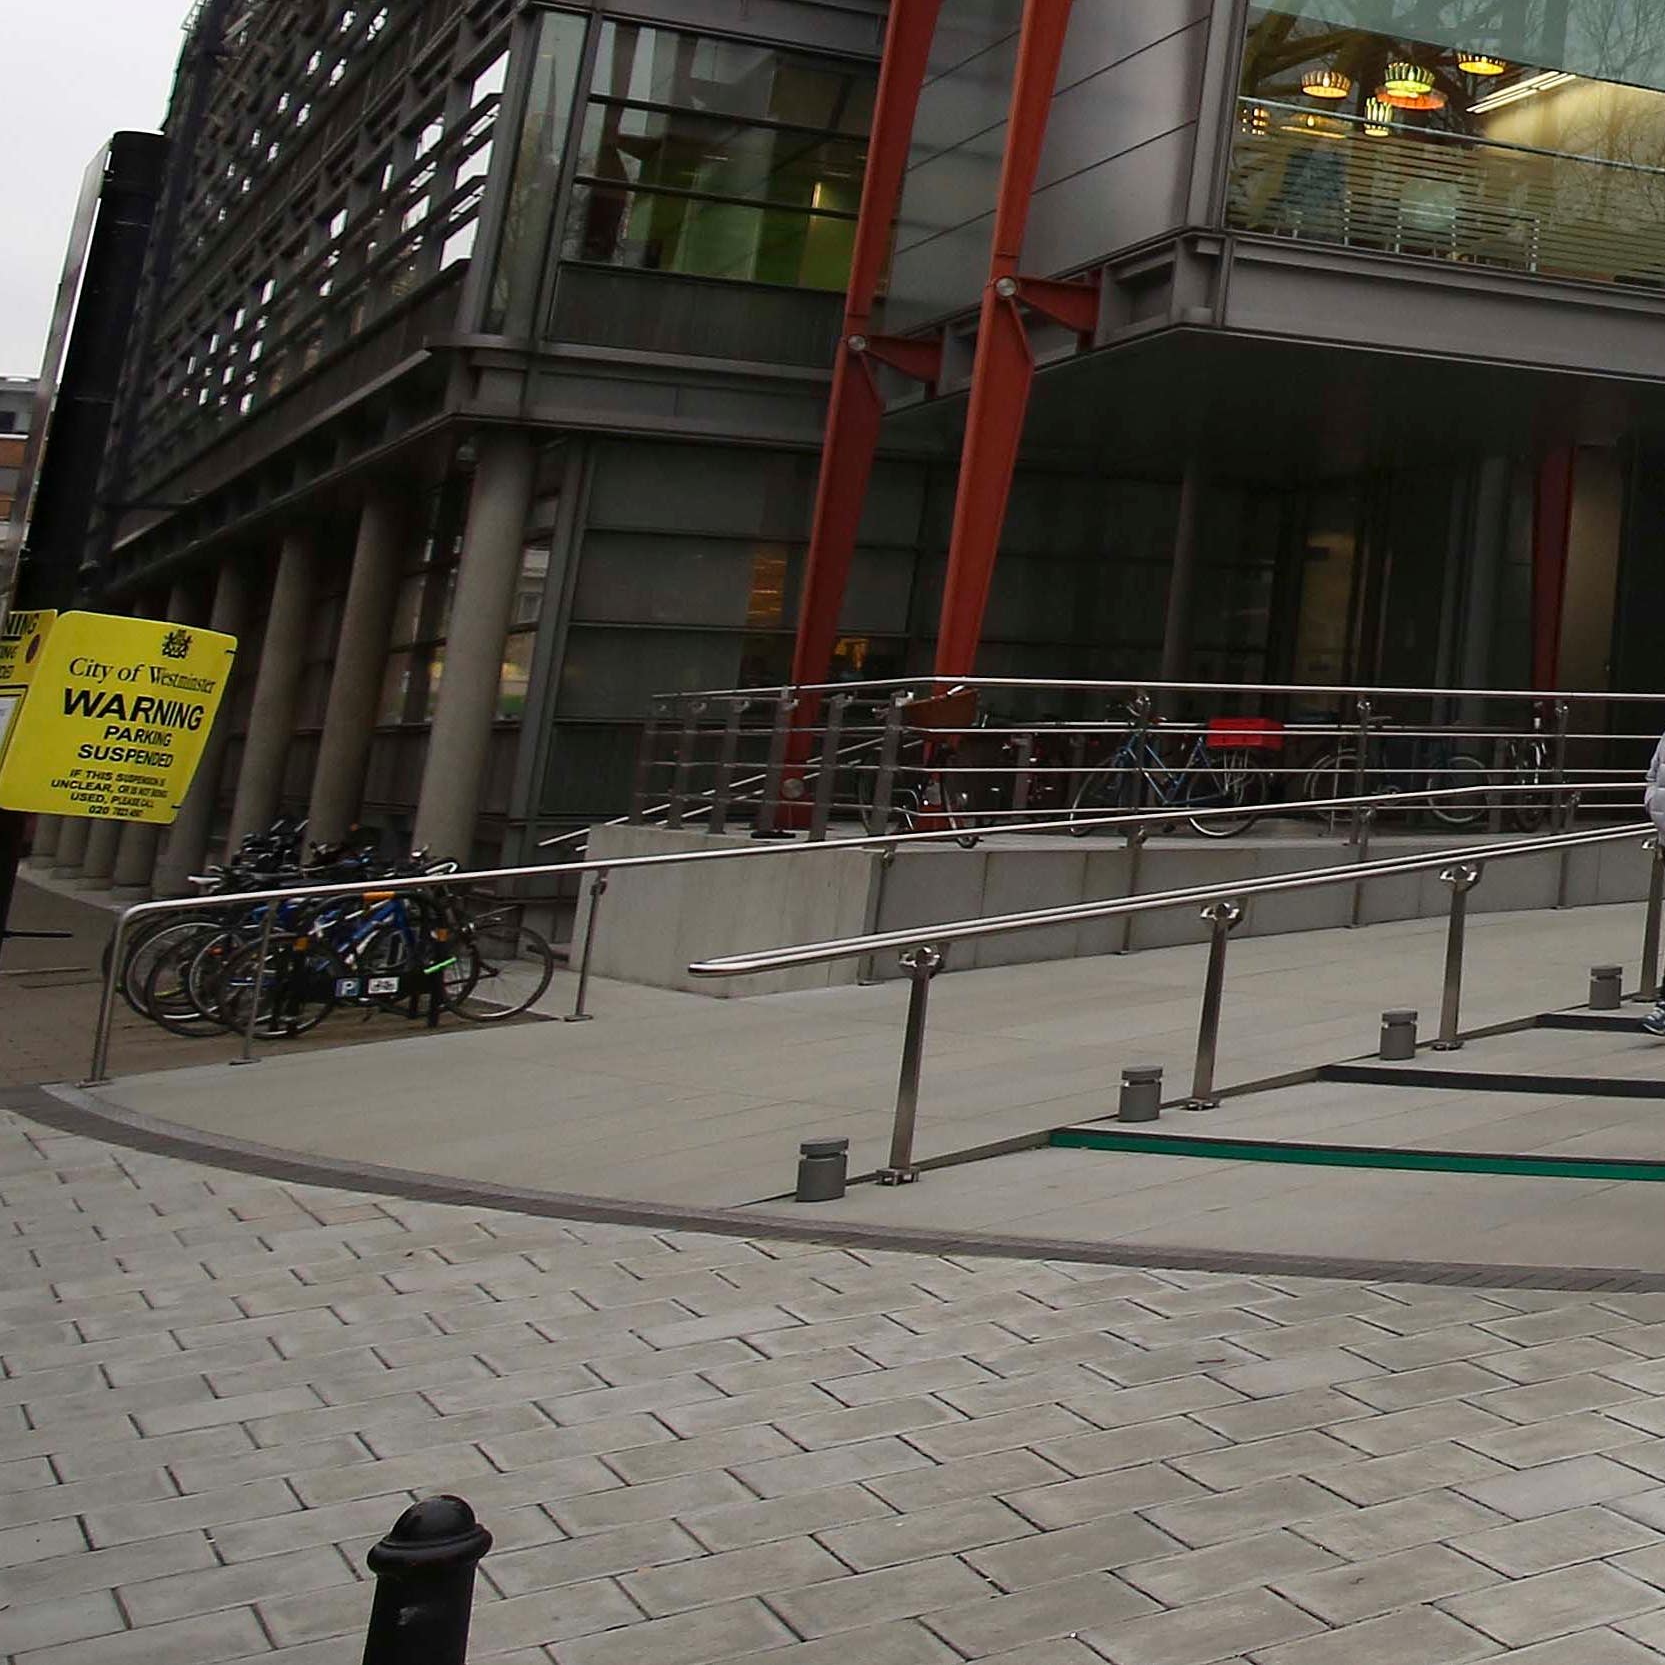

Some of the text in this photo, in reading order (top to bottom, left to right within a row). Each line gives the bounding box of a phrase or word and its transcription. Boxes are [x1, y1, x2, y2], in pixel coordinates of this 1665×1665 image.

[69, 657, 216, 694] City of Westminster
[63, 688, 205, 731] WARNING
[103, 725, 172, 747] PARKING
[77, 743, 174, 768] SUSPENDED
[69, 769, 83, 778] IF
[86, 770, 113, 781] THIS
[70, 793, 109, 804] USED,
[88, 805, 109, 815] 020
[341, 981, 355, 995] P
